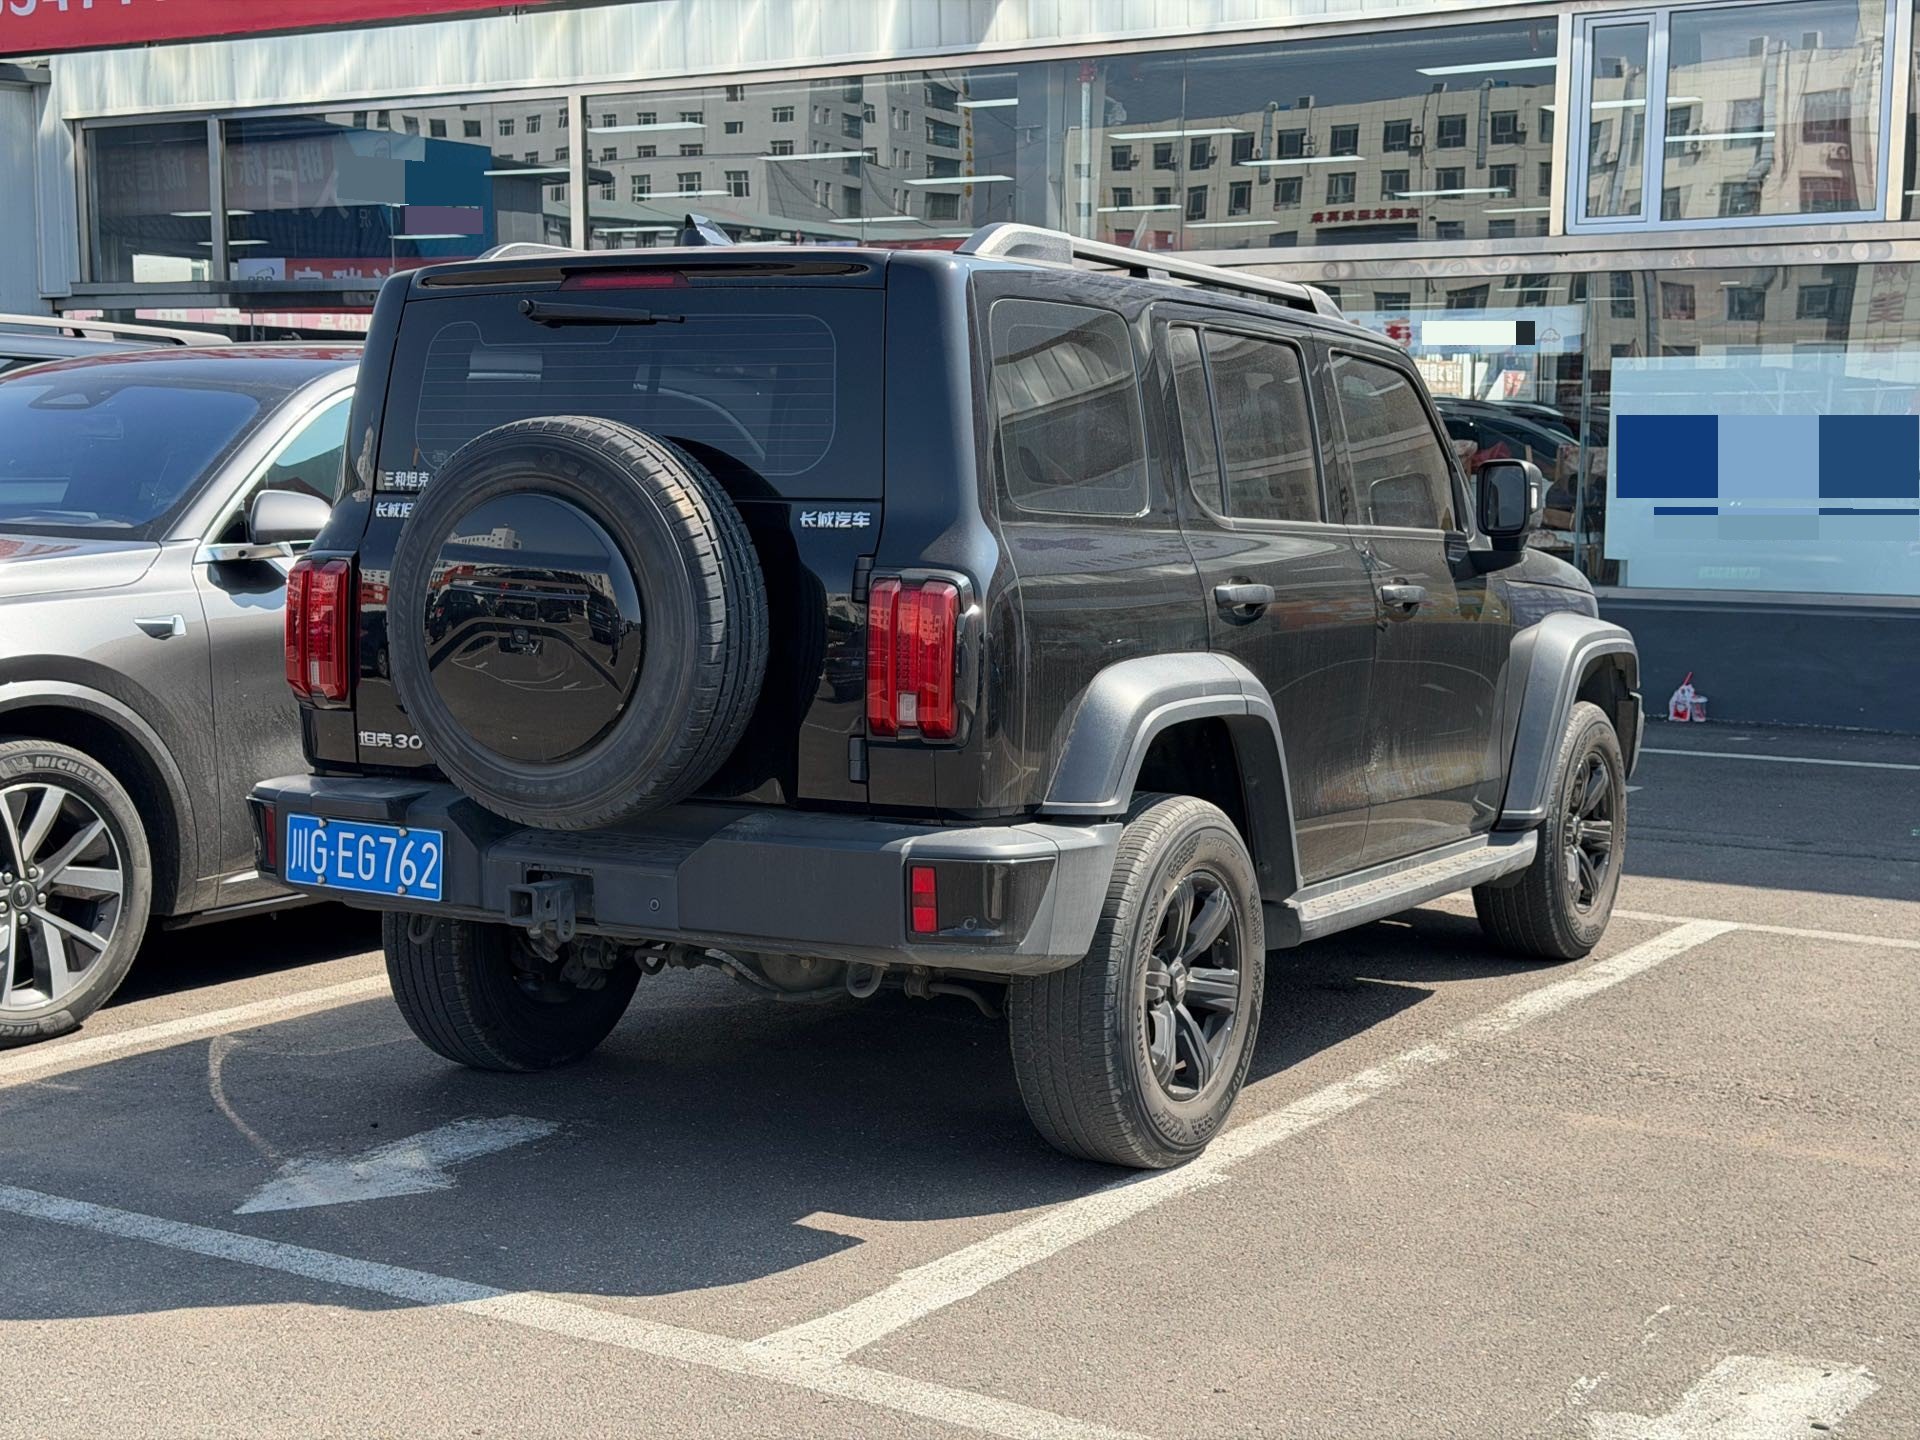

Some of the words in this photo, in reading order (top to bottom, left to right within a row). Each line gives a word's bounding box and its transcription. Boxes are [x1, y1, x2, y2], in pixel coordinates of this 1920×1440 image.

[384, 471, 430, 487] 三和坦克
[799, 511, 871, 528] 长城汽车
